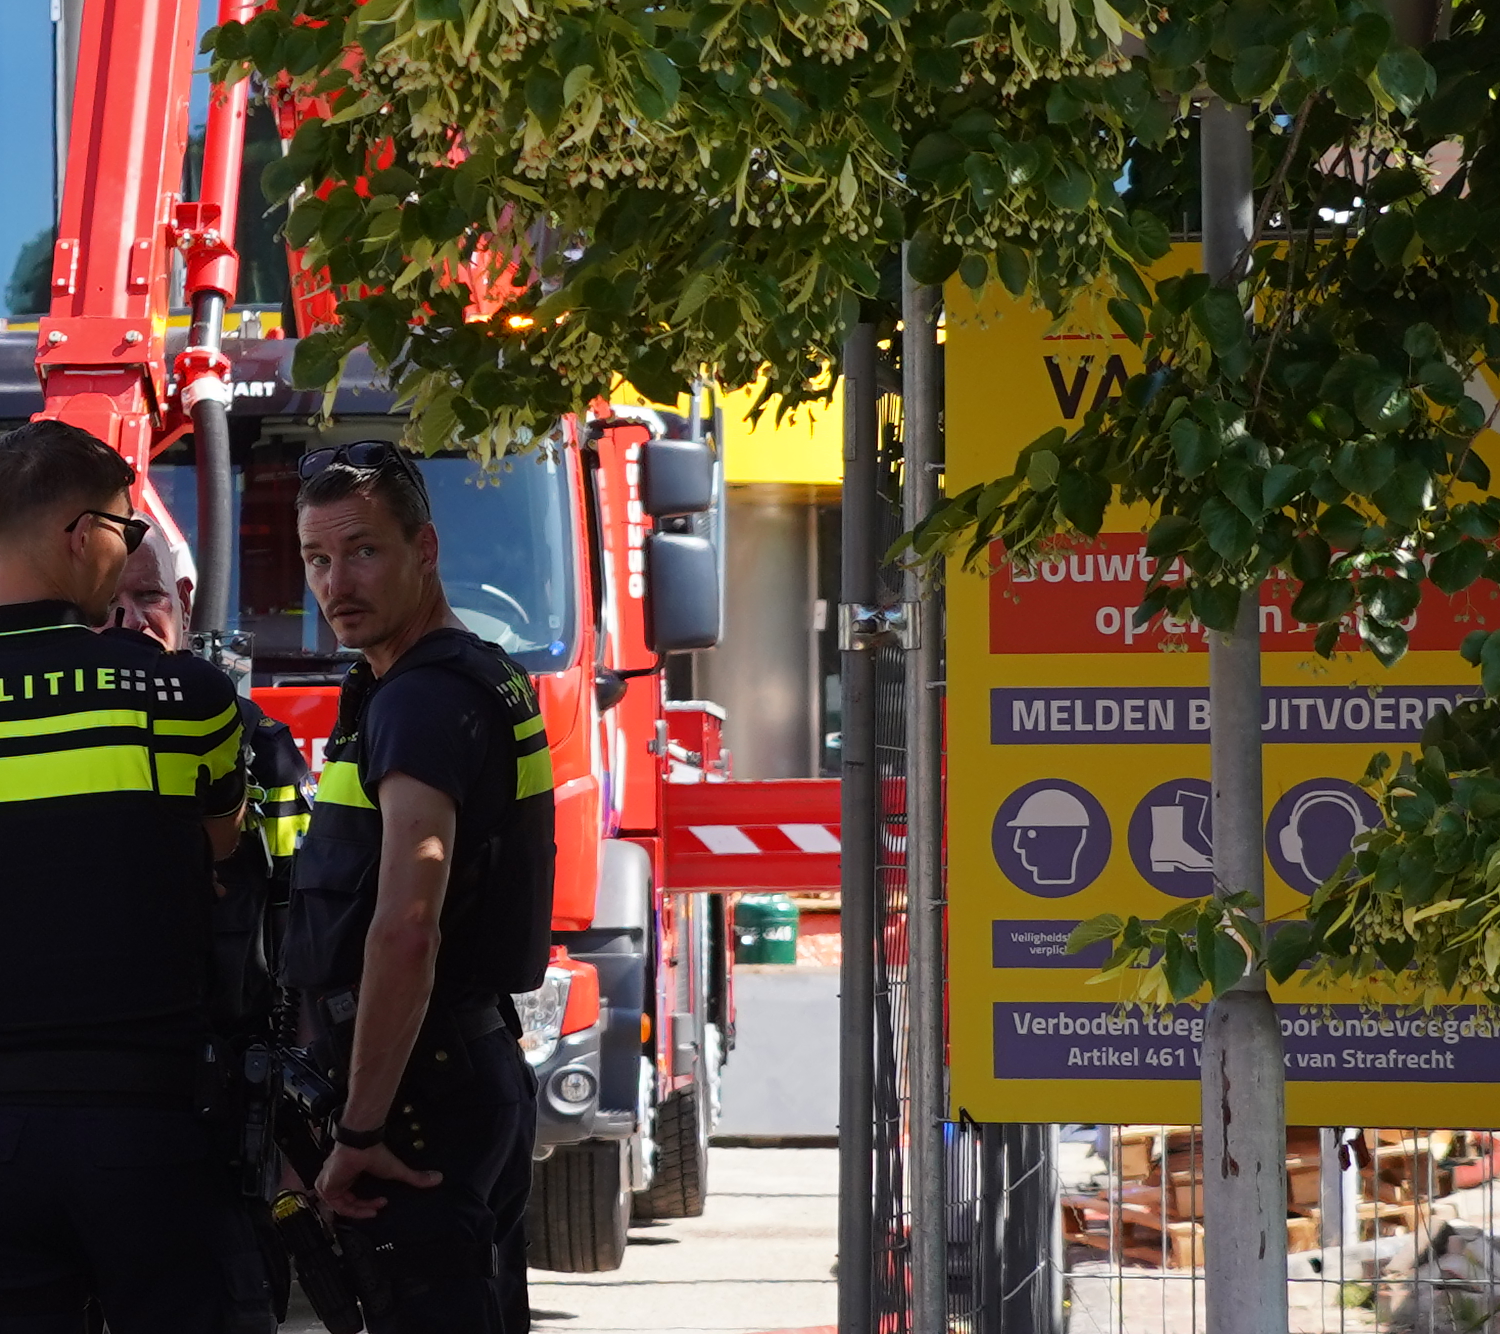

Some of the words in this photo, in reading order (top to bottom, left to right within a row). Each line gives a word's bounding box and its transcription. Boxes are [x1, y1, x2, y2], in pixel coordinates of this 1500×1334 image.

[1010, 697, 1176, 733] MELDEN
[1012, 1011, 1140, 1036] Verboden
[1067, 1046, 1140, 1067] Artikel
[1144, 1047, 1186, 1067] 461
[1296, 1052, 1337, 1069] van
[1341, 1047, 1456, 1070] Strafrecht
